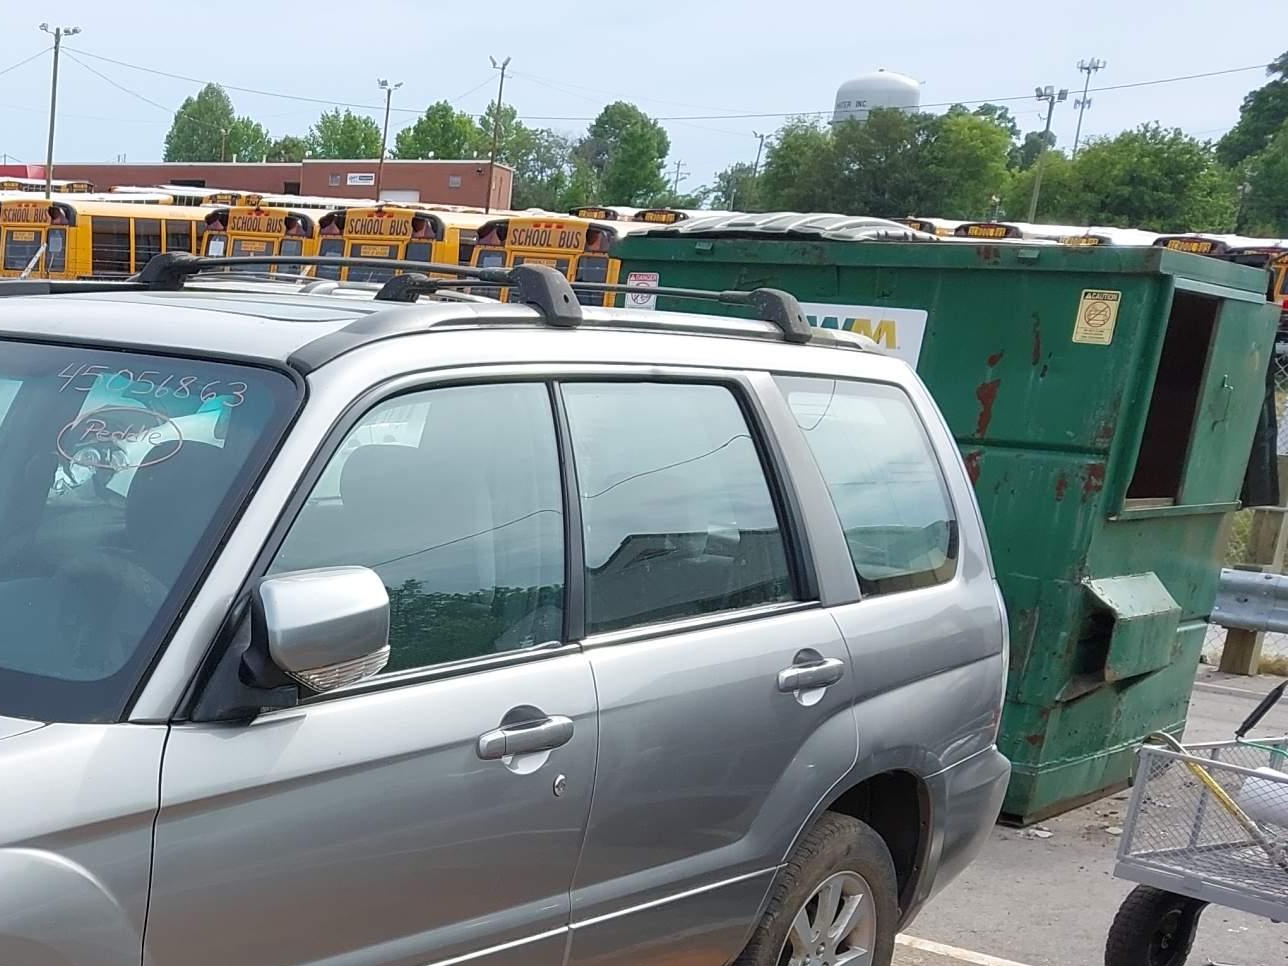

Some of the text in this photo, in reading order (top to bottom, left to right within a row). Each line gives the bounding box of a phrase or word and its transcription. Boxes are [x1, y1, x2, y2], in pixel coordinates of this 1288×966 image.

[3, 208, 48, 223] SCHOOL BUS
[231, 215, 283, 234] SCHOOL BUS
[348, 218, 409, 237] SCHOOL BUS
[511, 228, 582, 249] SCHOOL BUS
[58, 362, 248, 407] 45056863
